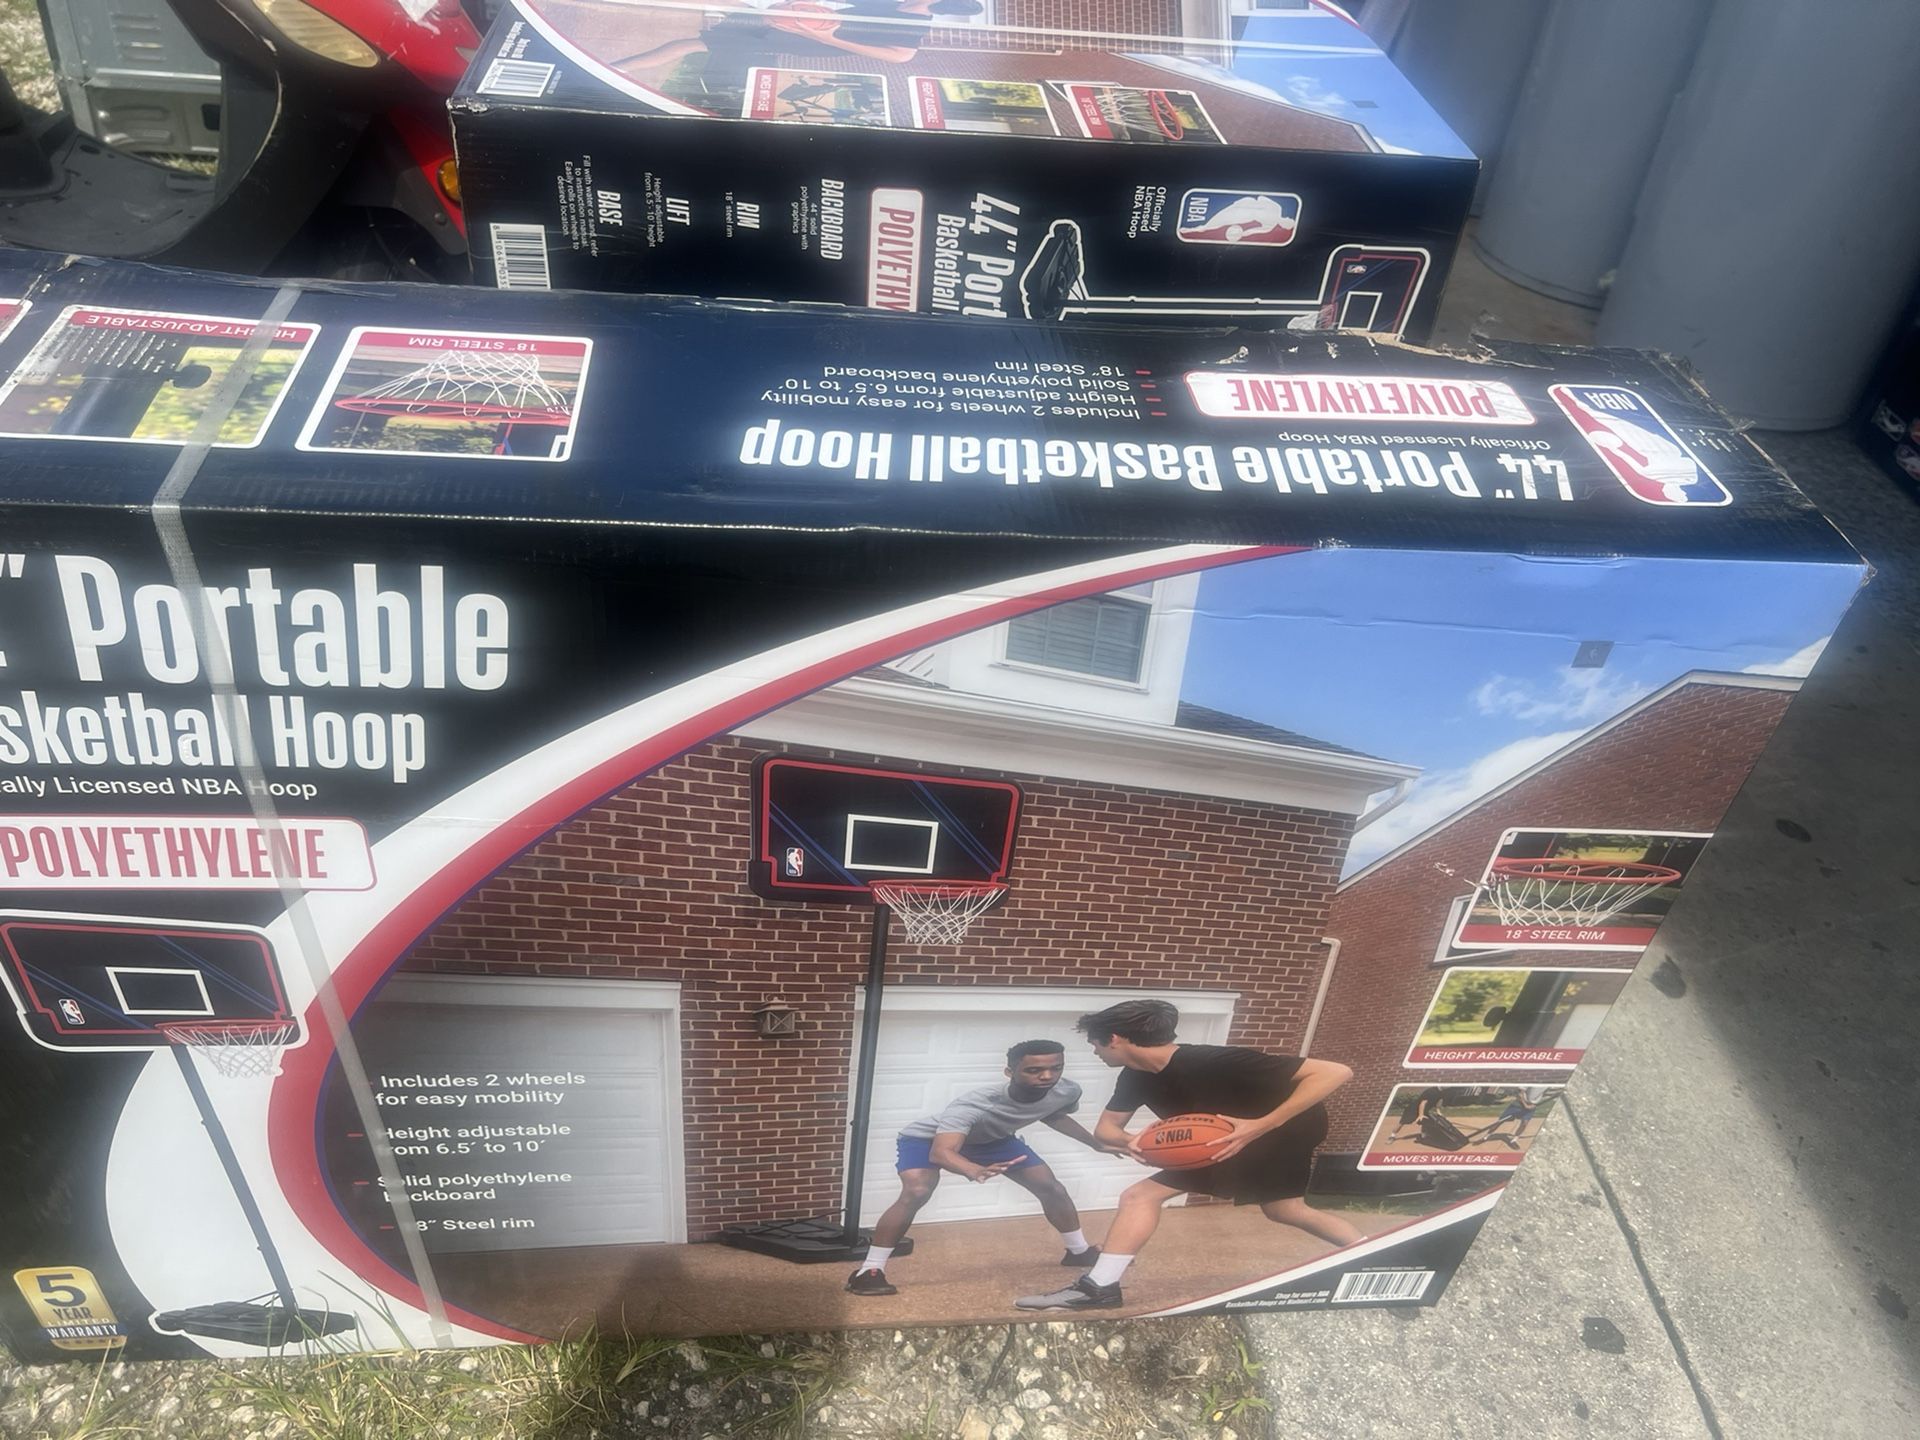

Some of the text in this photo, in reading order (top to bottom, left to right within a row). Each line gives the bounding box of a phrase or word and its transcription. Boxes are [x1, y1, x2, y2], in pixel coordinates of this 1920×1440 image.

[583, 155, 592, 166] Fill
[564, 161, 574, 184] Easily
[574, 168, 582, 176] to
[584, 168, 592, 184] with
[557, 176, 567, 204] desired
[644, 172, 652, 191] from
[568, 186, 576, 202] rolls
[576, 177, 585, 218] instruction
[570, 204, 576, 214] on
[588, 209, 594, 217] or
[597, 190, 623, 226] BASE
[653, 178, 664, 243] Height adjustable
[666, 197, 690, 226] LIFT
[726, 206, 734, 224] steel
[736, 202, 760, 229] RIM
[800, 186, 809, 232] polyethylene
[1127, 186, 1146, 239] NBA Hoop
[1140, 186, 1156, 232] Licensed
[1149, 186, 1167, 232] Officially
[1186, 196, 1210, 222] NBA
[791, 202, 800, 234] graphics
[810, 217, 818, 236] solid
[820, 178, 845, 260] BACKBOARD
[647, 225, 656, 248] height
[573, 242, 580, 250] to
[591, 240, 599, 258] refer
[962, 192, 1021, 318] 44" Port
[930, 213, 966, 312] Basketball
[85, 314, 218, 333] ADJUSTABLE
[408, 338, 538, 352] 18" STEEL RIM
[994, 361, 1125, 377] 18" Steel rim
[818, 380, 841, 391] to
[823, 366, 1130, 391] Solid polyethylene backboard
[895, 385, 946, 398] from
[952, 387, 1061, 402] adjustable
[1067, 390, 1136, 405] Height
[1233, 379, 1498, 418] POLYETHYLENE
[1586, 390, 1636, 410] NBA
[760, 389, 1141, 420] Includes 2 wheels for easy mobility
[1278, 432, 1551, 450] Officially Licensed NBA Hoop
[738, 418, 1574, 501] 44" Portable Basketball Hoop
[55, 554, 509, 691] Portable
[269, 695, 426, 784] Hoop
[0, 775, 46, 797] ally
[53, 776, 174, 796] Licensed
[181, 778, 242, 795] NBA
[0, 826, 328, 879] POLYETHYLENE
[1505, 928, 1606, 941] 18" STEEL RIM
[1424, 1050, 1564, 1062] HEIGHT ADJUSTABLE
[380, 1072, 586, 1088] Includes 2 wheels
[375, 1090, 565, 1108] for easy mobility
[457, 1124, 572, 1140] adjustable
[1166, 1128, 1193, 1142] NBA
[483, 1141, 506, 1154] to
[1383, 1154, 1498, 1164] MOVES WITH EASE
[377, 1172, 573, 1189] Slid polyethylene
[383, 1188, 497, 1202] bckboard
[407, 1216, 536, 1232] 8" Steel rim
[36, 1273, 87, 1308] 5
[52, 1306, 93, 1320] YEAR
[47, 1318, 110, 1327] LIMITED
[47, 1324, 119, 1339] WARRANTY
